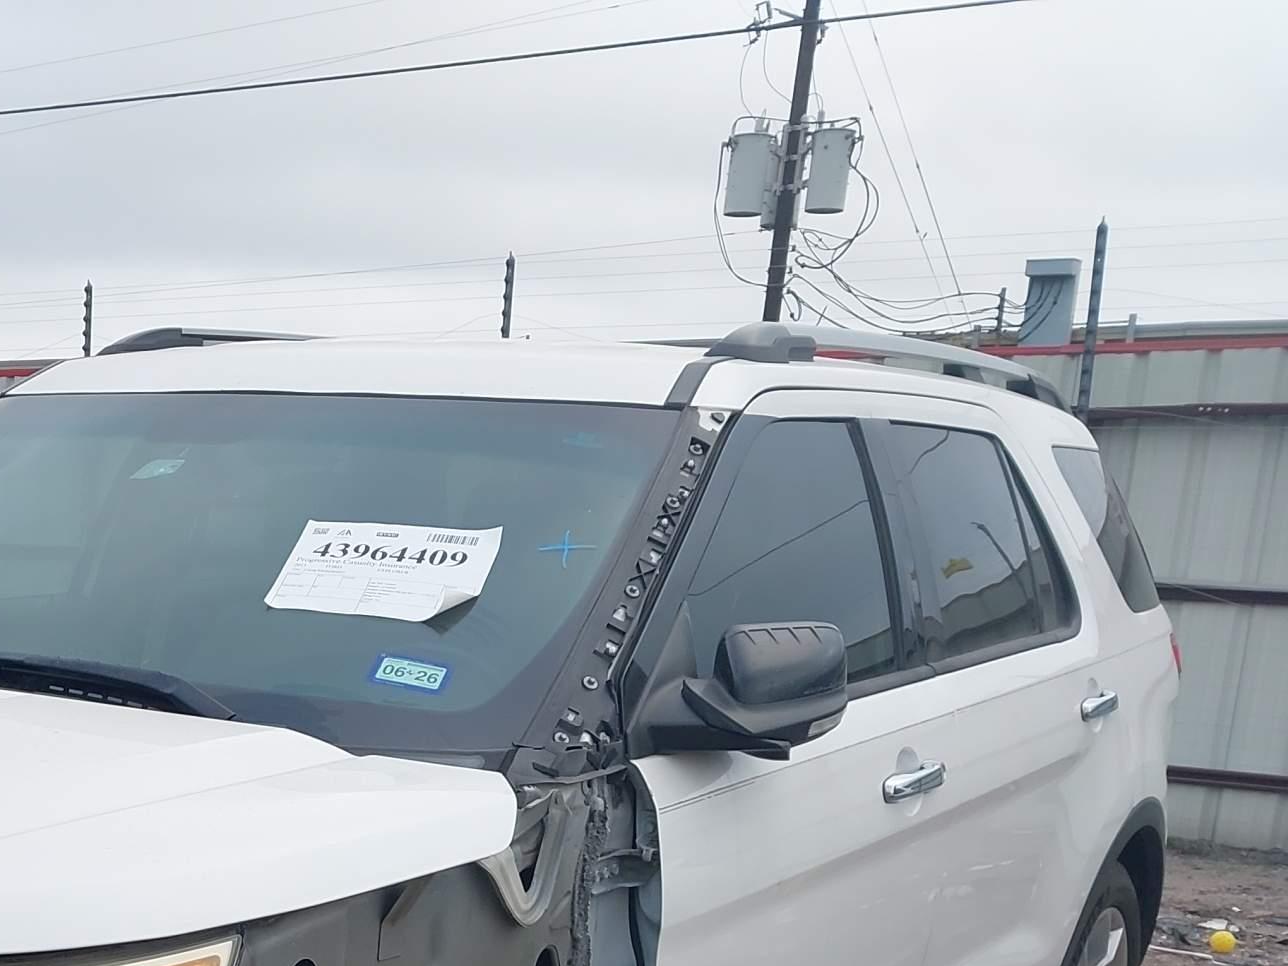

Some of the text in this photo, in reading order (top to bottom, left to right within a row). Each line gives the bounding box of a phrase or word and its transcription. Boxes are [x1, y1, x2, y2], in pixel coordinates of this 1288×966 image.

[312, 542, 468, 567] 43964409
[382, 664, 440, 684] 06 26
